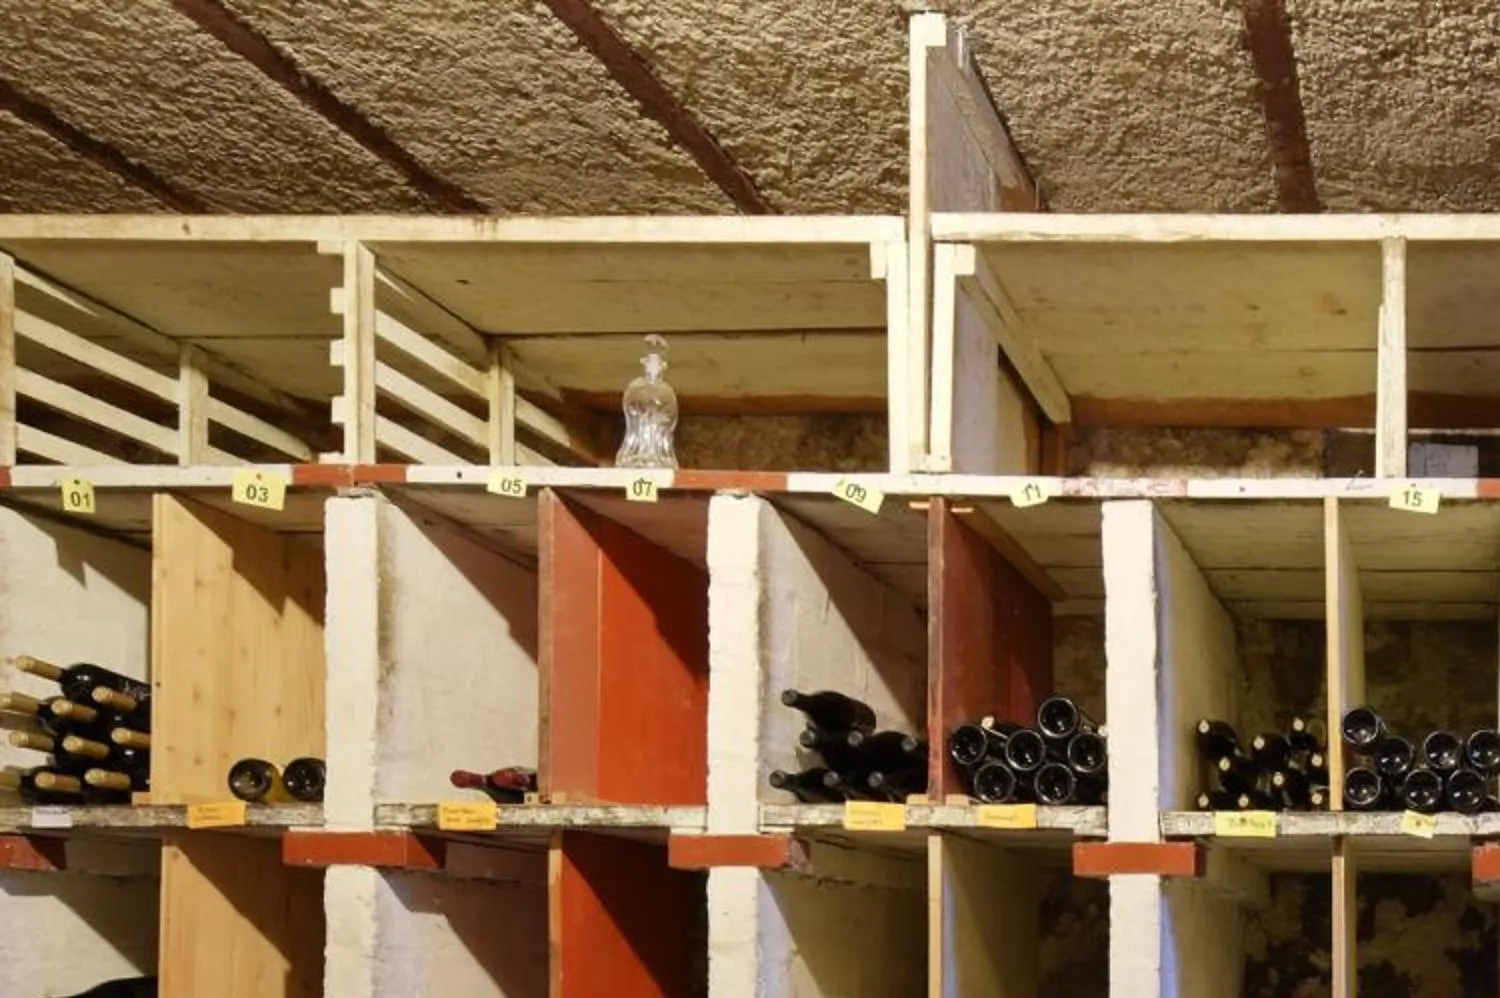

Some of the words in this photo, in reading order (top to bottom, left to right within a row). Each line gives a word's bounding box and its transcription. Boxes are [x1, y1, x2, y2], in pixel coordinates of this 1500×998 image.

[246, 484, 269, 502] 03
[501, 479, 522, 494] 05
[633, 480, 652, 497] 07
[846, 483, 867, 502] 09
[71, 491, 91, 507] 01
[1403, 491, 1422, 507] 15
